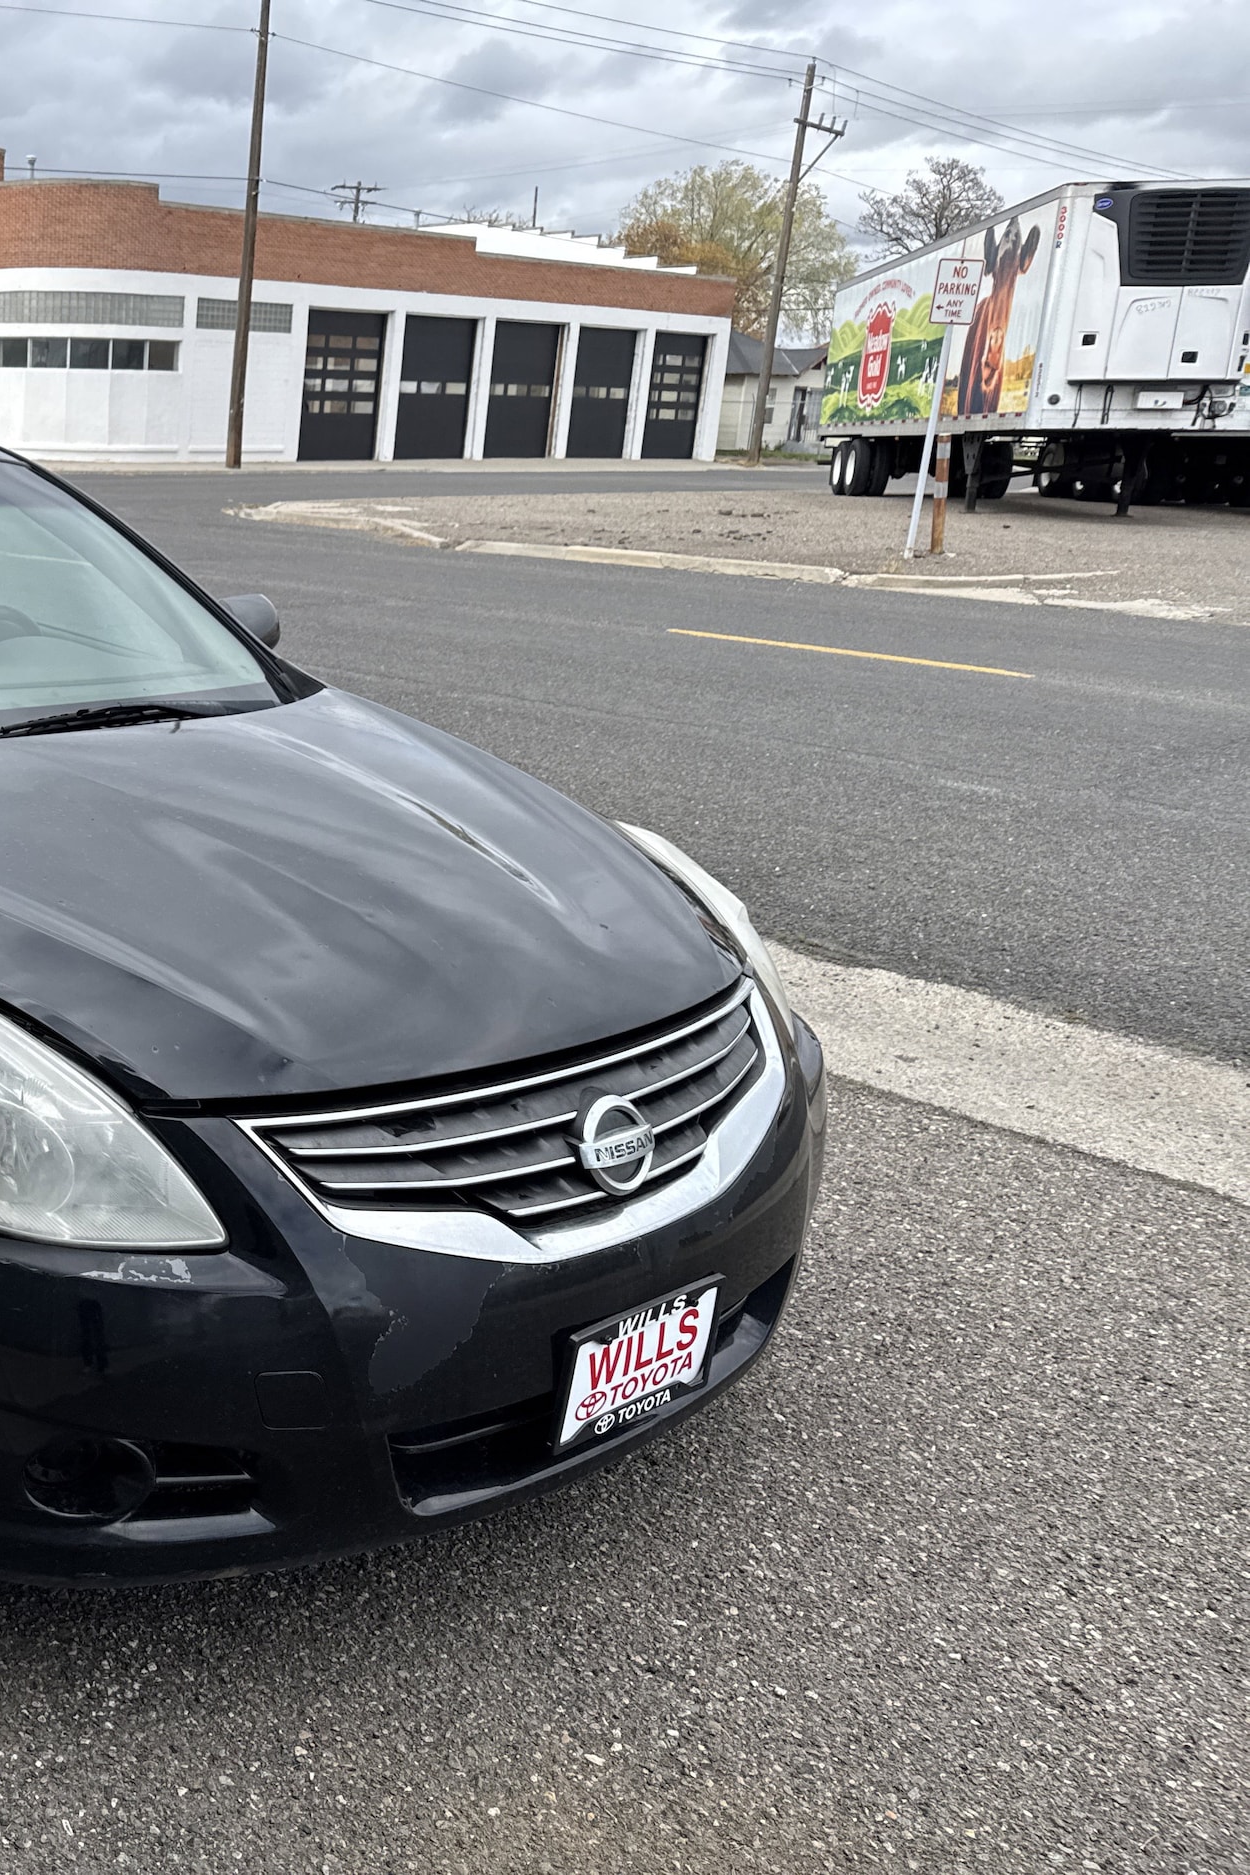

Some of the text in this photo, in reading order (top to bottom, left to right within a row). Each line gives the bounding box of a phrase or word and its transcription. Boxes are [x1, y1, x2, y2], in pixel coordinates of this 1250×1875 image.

[953, 266, 969, 279] NO
[938, 282, 977, 296] PARKING
[944, 309, 962, 318] TIME
[946, 300, 964, 308] ANY
[867, 353, 882, 378] Gold
[594, 1130, 654, 1162] NISSAN
[618, 1294, 687, 1337] WILLS
[589, 1308, 699, 1391] WILLS
[610, 1351, 693, 1406] TOYOTA
[618, 1388, 671, 1423] TOYOTA
